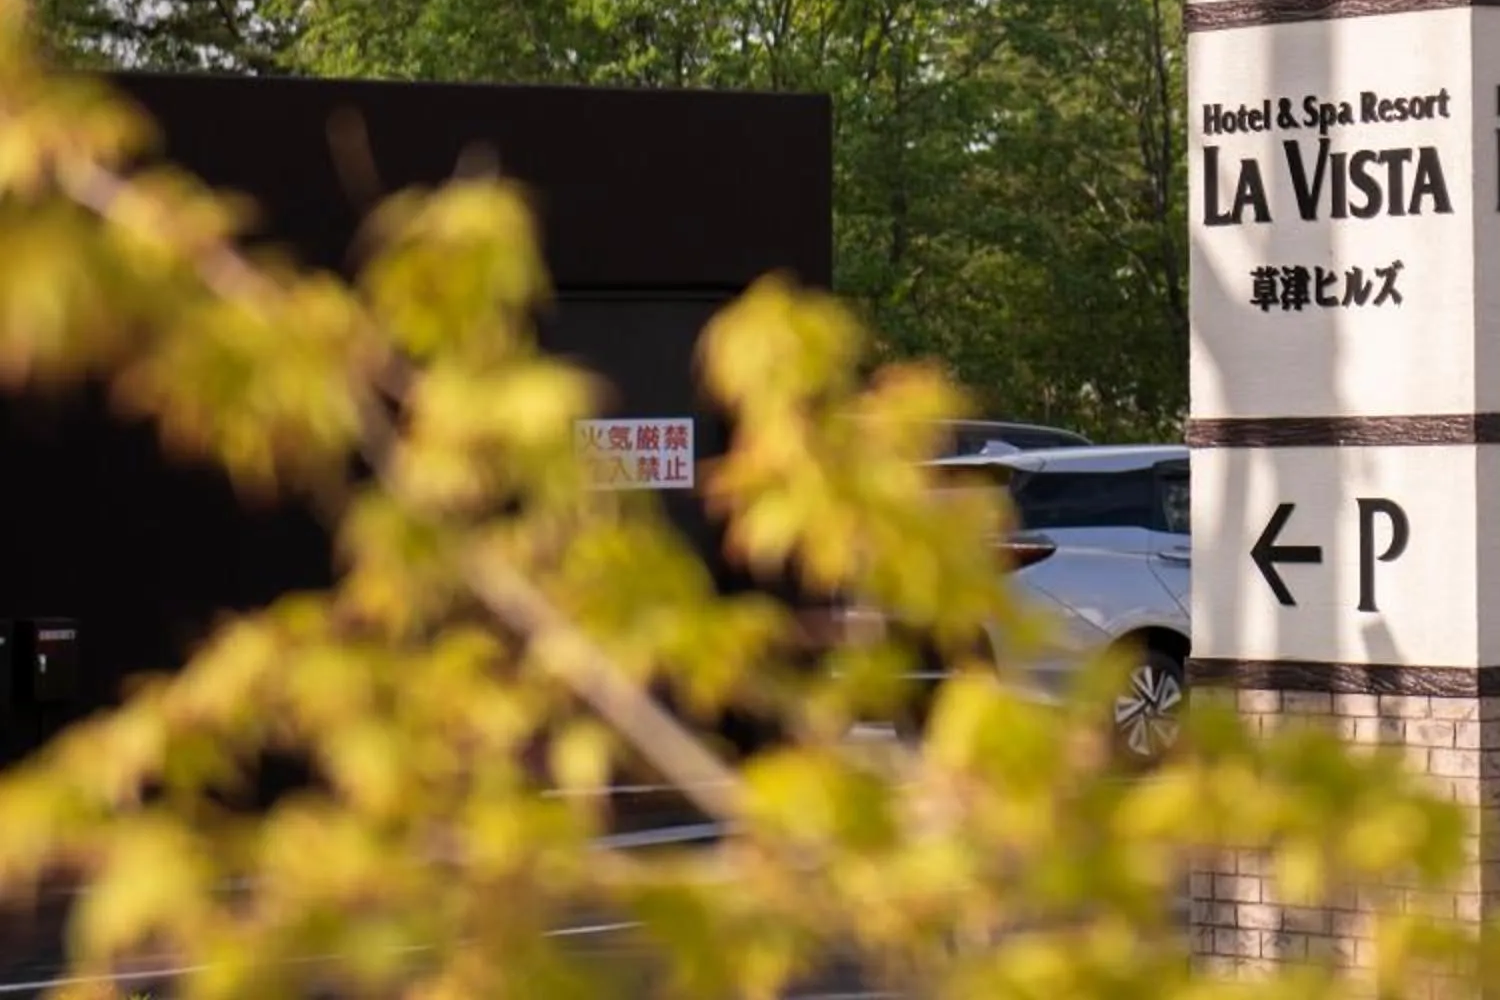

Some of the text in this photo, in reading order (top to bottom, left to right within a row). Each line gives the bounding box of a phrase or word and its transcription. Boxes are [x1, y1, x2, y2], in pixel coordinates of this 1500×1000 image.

[1203, 88, 1451, 135] Hotel & Spa Resort
[1203, 138, 1454, 226] LA VISTA
[1250, 259, 1404, 312] 草津ヒルズ
[1356, 497, 1410, 612] P
